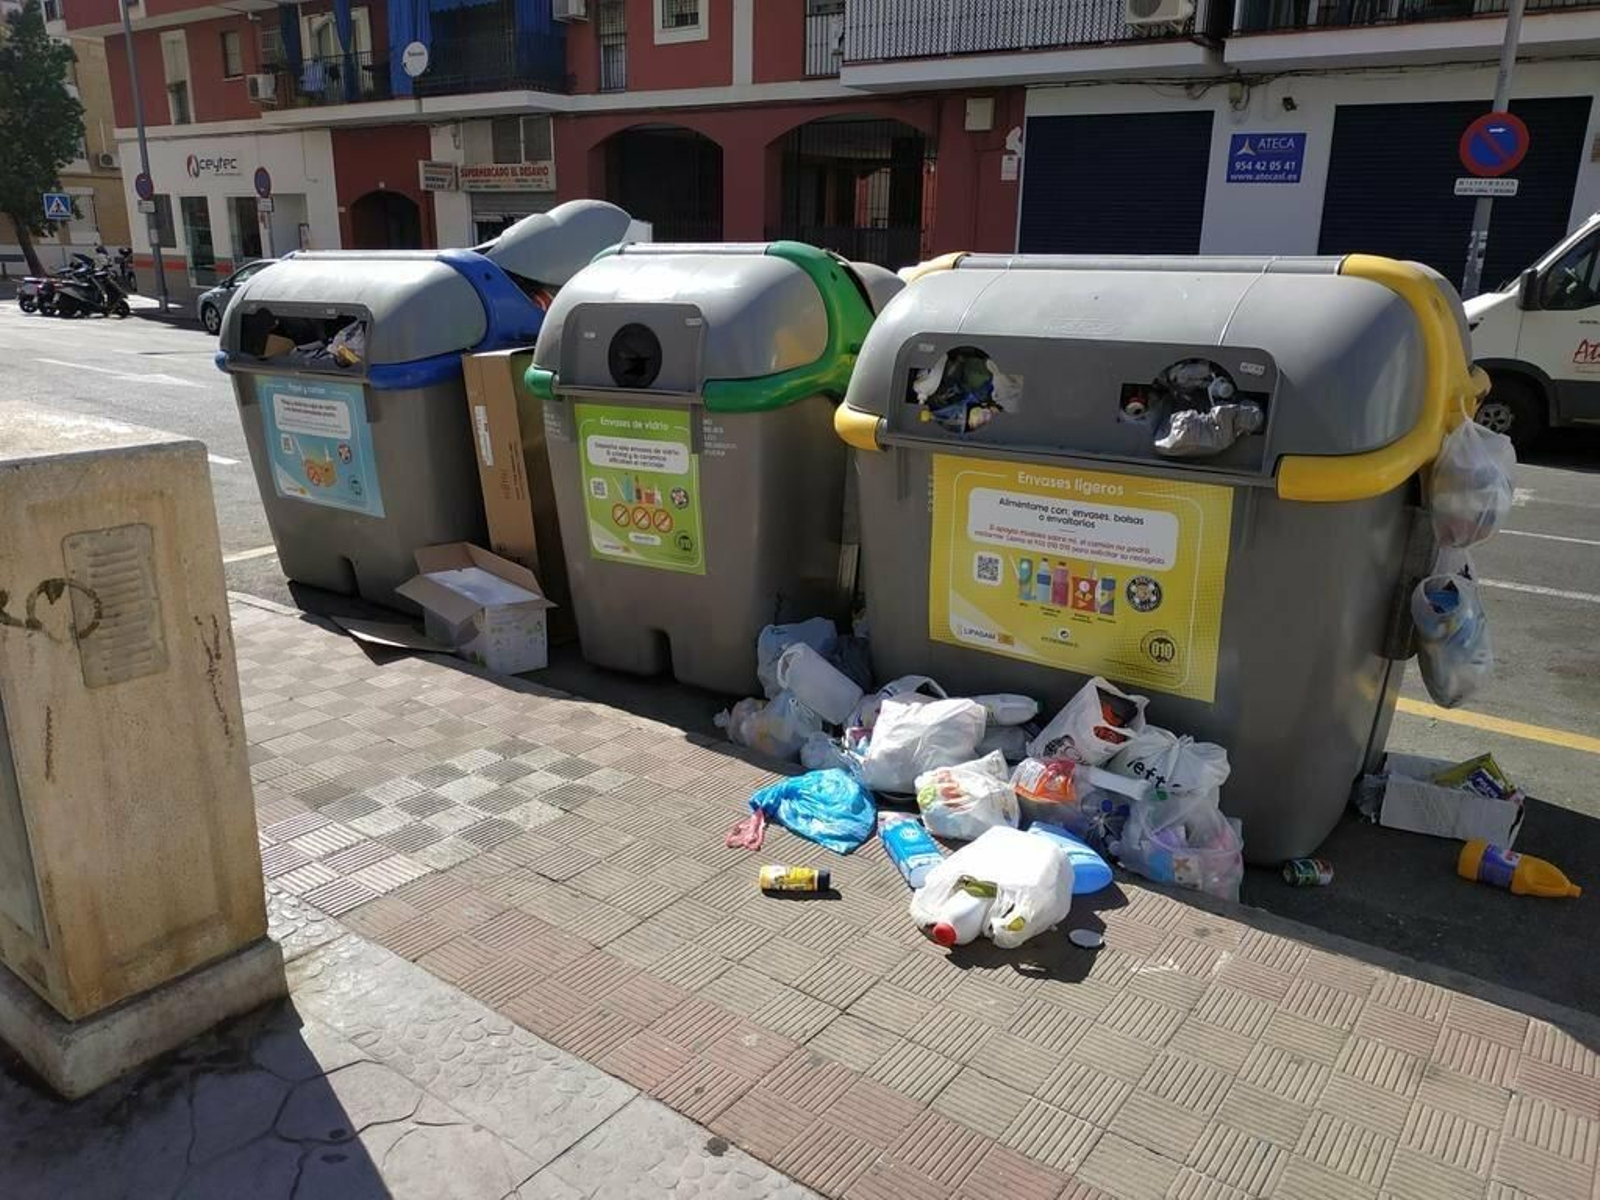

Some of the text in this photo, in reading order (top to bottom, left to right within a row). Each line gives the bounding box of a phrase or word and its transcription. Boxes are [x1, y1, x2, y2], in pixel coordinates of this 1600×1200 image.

[1258, 137, 1296, 149] ATECA
[460, 166, 509, 178] SUPERMERCADO
[1235, 161, 1296, 171] 954 42 05 41
[600, 416, 669, 431] Envases de vidrio
[1018, 471, 1124, 496] Envases ligeros
[1038, 514, 1096, 529] o envoltorios
[1114, 514, 1145, 526] bolsas
